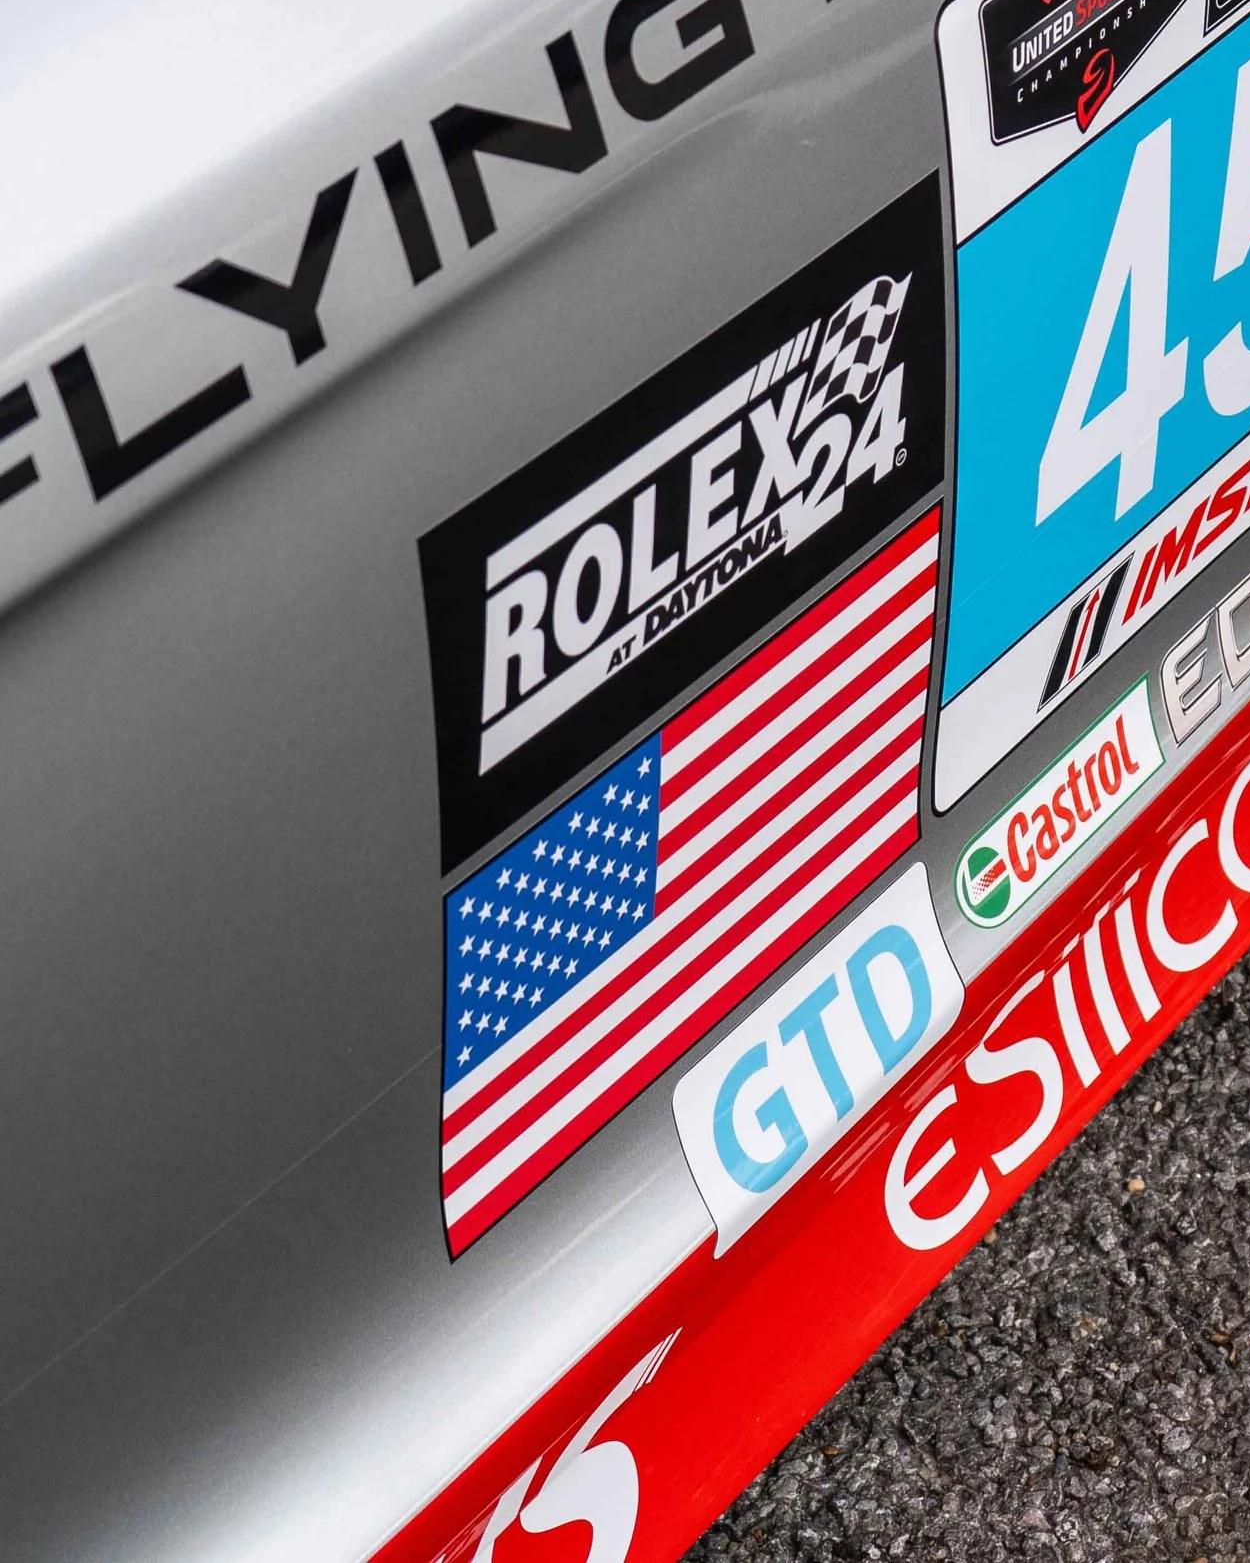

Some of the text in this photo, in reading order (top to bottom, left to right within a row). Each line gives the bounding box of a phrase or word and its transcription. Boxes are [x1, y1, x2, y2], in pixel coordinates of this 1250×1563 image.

[1012, 10, 1074, 73] UNITED
[482, 362, 907, 725] ROLEX 24
[606, 512, 784, 675] AT DAYTONA
[1006, 714, 1140, 882] Castrol
[712, 924, 933, 1195] GTD
